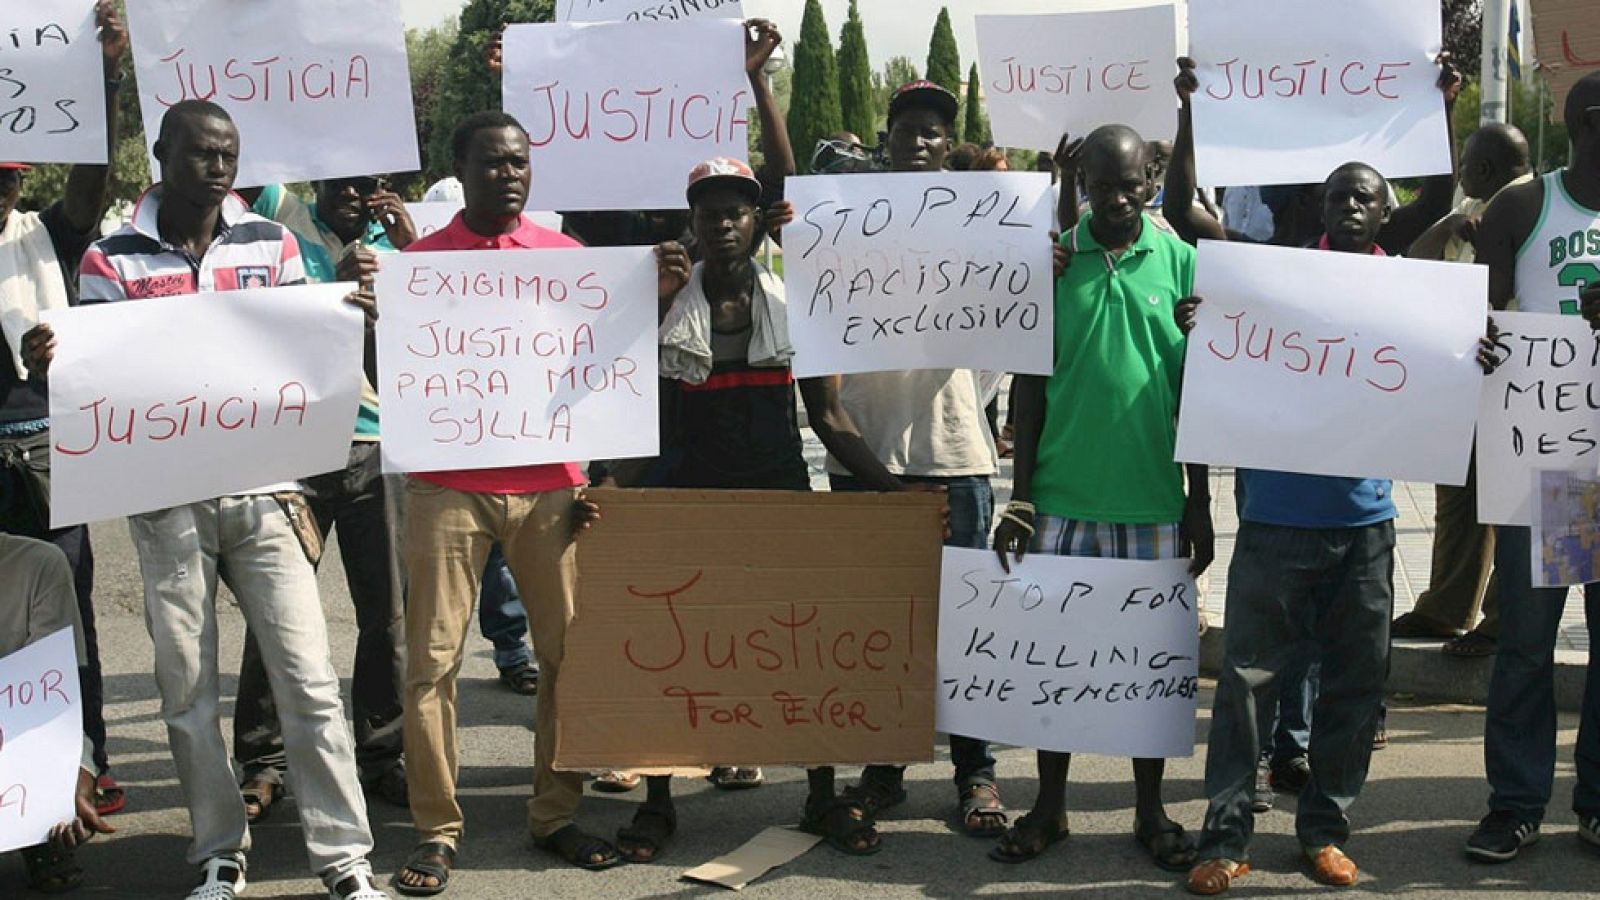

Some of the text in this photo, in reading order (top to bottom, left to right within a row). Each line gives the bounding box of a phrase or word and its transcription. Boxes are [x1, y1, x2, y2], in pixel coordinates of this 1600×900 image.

[0, 23, 70, 49] IA
[992, 56, 1150, 95] JUSTICE
[1206, 53, 1411, 100] JUSTICE
[0, 99, 80, 134] OS
[1548, 228, 1600, 268] BOS
[407, 265, 609, 311] EXIGIMOS
[808, 260, 1031, 317] RACISMO
[407, 319, 596, 358] JUSTICIA
[1208, 311, 1408, 392] JUSTIS
[397, 357, 642, 399] PARA MOR
[54, 381, 307, 455] JUSTICIA
[428, 403, 571, 446] SYLLA
[1511, 425, 1597, 457] DES
[956, 569, 1191, 614] STOP FOR
[964, 626, 1193, 670] KILLING
